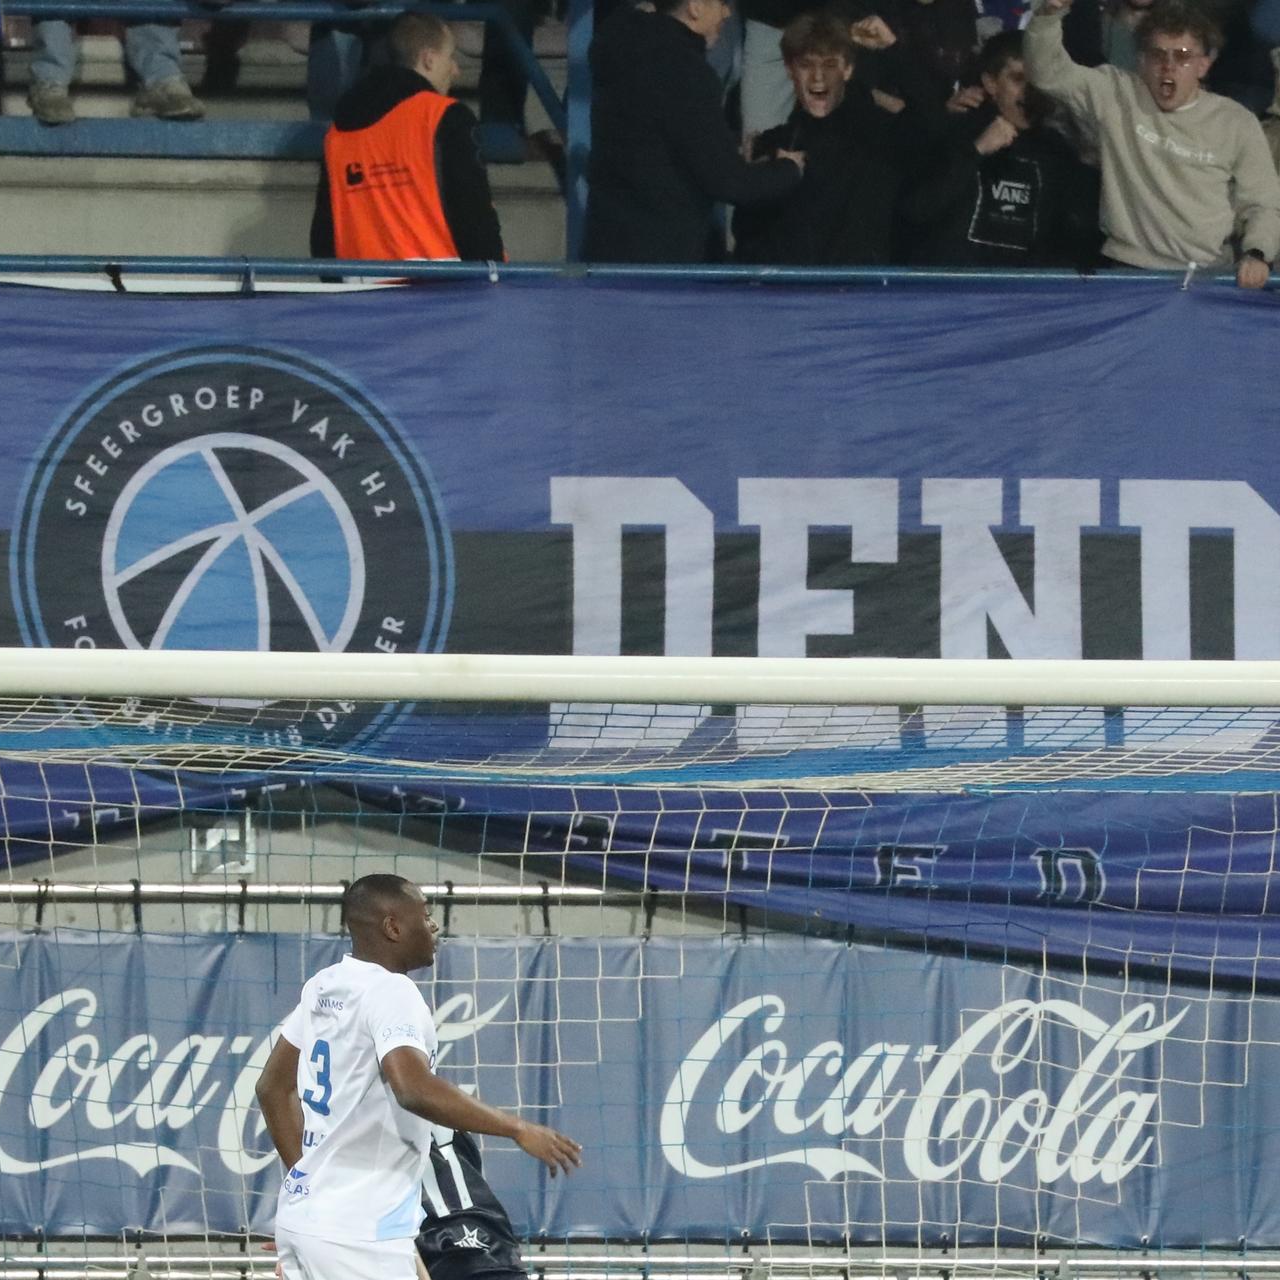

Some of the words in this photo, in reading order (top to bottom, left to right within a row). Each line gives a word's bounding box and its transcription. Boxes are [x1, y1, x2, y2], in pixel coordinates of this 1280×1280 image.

[1136, 124, 1216, 163] cahartt
[991, 181, 1031, 205] VANS
[66, 385, 264, 517] SFEERGROEP
[292, 399, 356, 459] VAK
[360, 470, 398, 518] H2
[303, 1039, 333, 1117] 3
[660, 995, 1191, 1184] Coca-Cola
